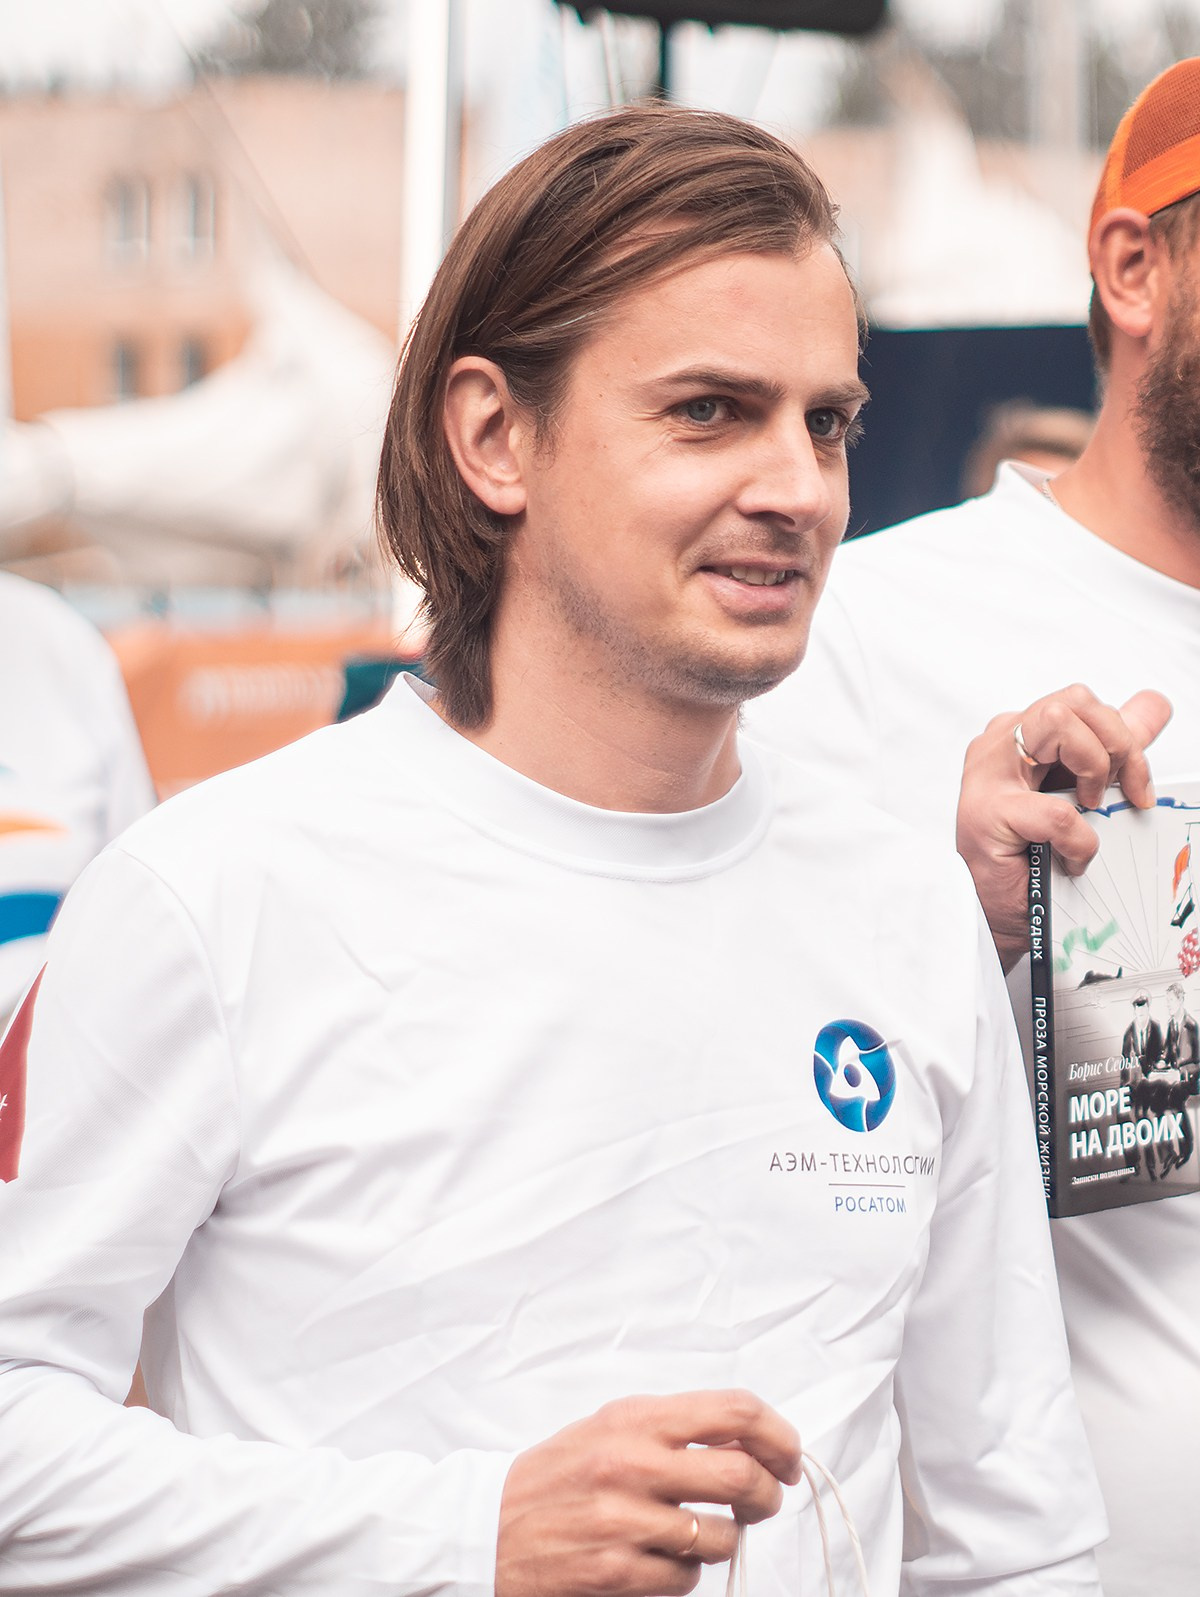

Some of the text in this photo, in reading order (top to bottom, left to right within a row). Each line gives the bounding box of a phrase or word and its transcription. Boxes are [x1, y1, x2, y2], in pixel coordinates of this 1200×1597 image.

[1030, 844, 1043, 898] Борис
[1031, 904, 1045, 960] Седых
[1035, 996, 1047, 1050] ПРОЗА
[1069, 1054, 1145, 1081] Борис Седых
[1037, 1055, 1051, 1135] МОРСКОЙ
[1070, 1086, 1131, 1124] МОРЕ
[1070, 1112, 1185, 1159] НА ДВОИХ
[769, 1152, 936, 1176] АЭМ-ТЕХНОЛОГИИ
[835, 1196, 907, 1213] РОСАТОМ
